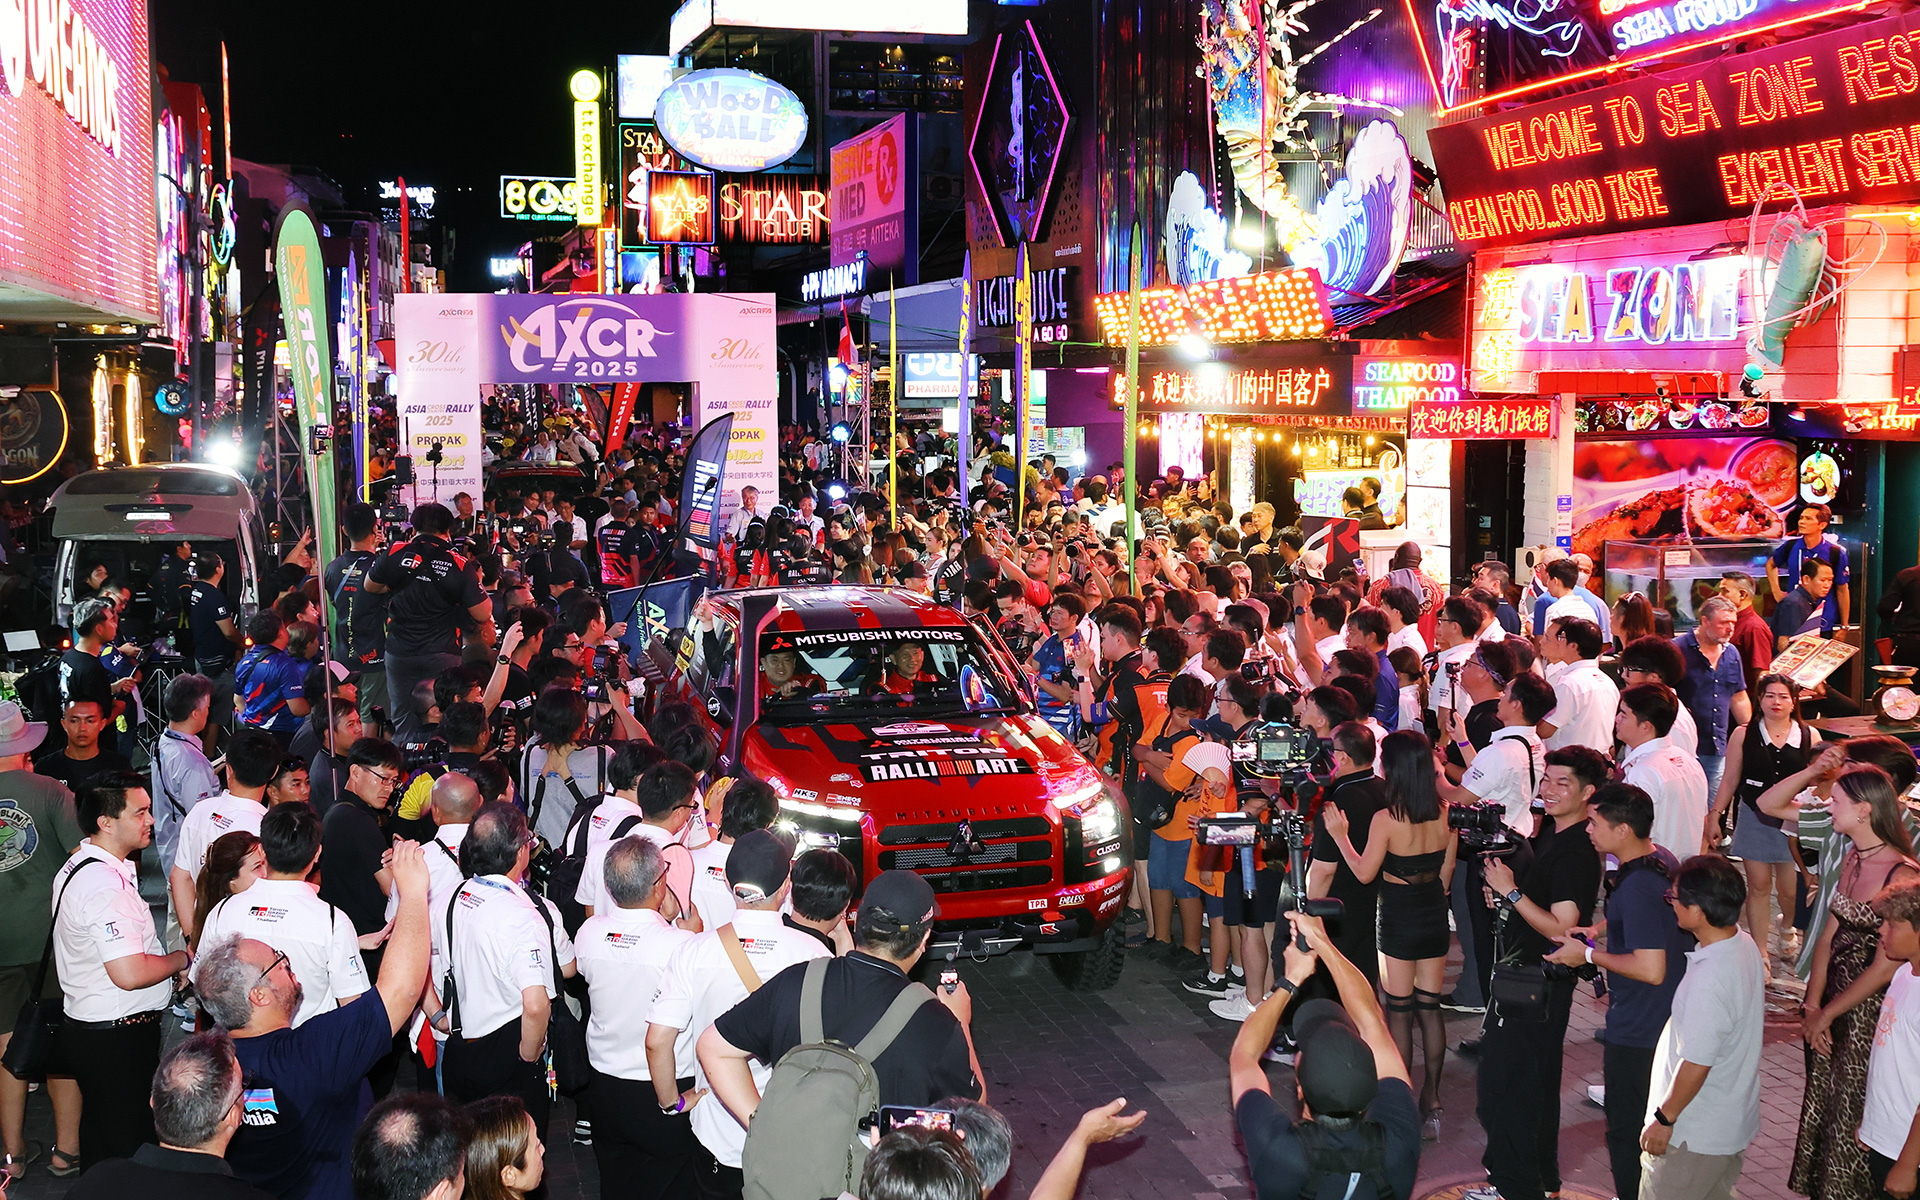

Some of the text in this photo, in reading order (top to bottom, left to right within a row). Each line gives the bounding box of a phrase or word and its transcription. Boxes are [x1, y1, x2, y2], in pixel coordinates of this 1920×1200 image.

[1484, 104, 1603, 172] WELCOME
[1604, 95, 1646, 147] TO
[1656, 80, 1722, 137] SEA
[1729, 55, 1825, 127] ZONE
[694, 114, 776, 143] BALL
[712, 156, 766, 168] KARAOKE
[834, 138, 875, 187] SERVE
[1604, 168, 1670, 219] TASTE
[1717, 137, 1850, 206] EXCELLENT
[651, 193, 709, 214] STARS
[839, 181, 866, 222] MED
[763, 221, 812, 236] CLUB
[739, 307, 772, 315] AXCRFA
[1516, 264, 1739, 345] SEA ZONE
[438, 309, 473, 317] AXCRFA
[1041, 326, 1053, 341] GO
[1056, 325, 1067, 340] GO
[408, 340, 466, 363] 30th
[711, 338, 764, 360] 30th
[574, 361, 638, 377] 2025
[1365, 362, 1456, 382] SEAFOOD
[908, 384, 975, 394] PHARMAY
[405, 405, 427, 414] ASIA
[445, 403, 474, 413] RALLY
[707, 401, 728, 410] ASIA
[745, 400, 773, 409] RALLY
[425, 415, 454, 426] 2025
[733, 411, 753, 421] 025
[1411, 405, 1550, 435] 欢迎你到我们饭馆
[416, 435, 462, 446] PROPAK
[795, 629, 965, 646] MITSUBISHI MOTORS
[860, 748, 1008, 760] TRITON
[794, 789, 817, 798] HKS
[837, 795, 861, 803] ENEOS
[0, 809, 23, 823] BLIN
[896, 804, 1029, 820] MITSUBISHI
[1096, 842, 1121, 856] CUSCO
[1030, 900, 1047, 909] TPR
[1058, 894, 1085, 905] ENDLESS
